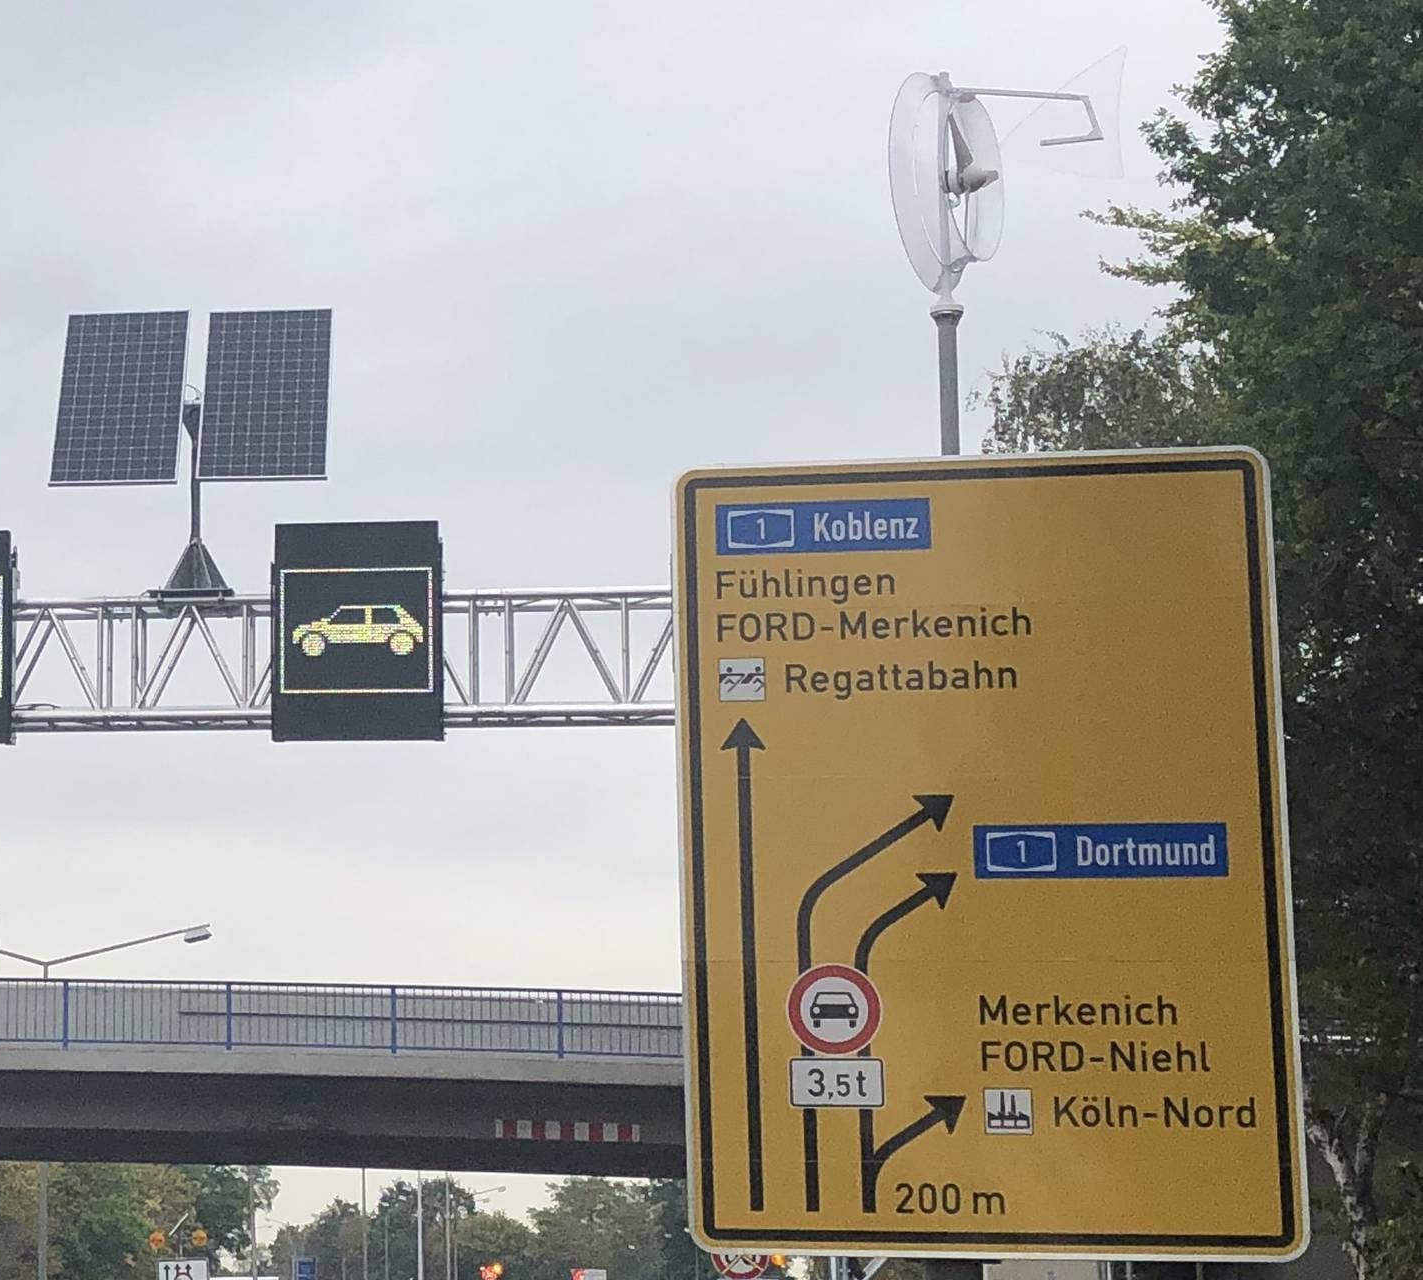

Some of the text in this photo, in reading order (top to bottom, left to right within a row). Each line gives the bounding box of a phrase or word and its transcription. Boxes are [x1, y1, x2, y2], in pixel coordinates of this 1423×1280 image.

[755, 518, 767, 541] 1
[813, 511, 920, 542] Koblenz
[715, 568, 896, 604] Fühlingen
[717, 607, 1032, 643] FORD-Merkenich
[785, 661, 1017, 700] Regattabahn
[1016, 839, 1027, 863] 1
[1076, 834, 1217, 867] Dortmund
[979, 995, 1179, 1026] Merkenich
[981, 1040, 1211, 1073] FORD-Niehl
[1054, 1095, 1257, 1129] Köln-Nord
[895, 1184, 1006, 1215] 200 m
